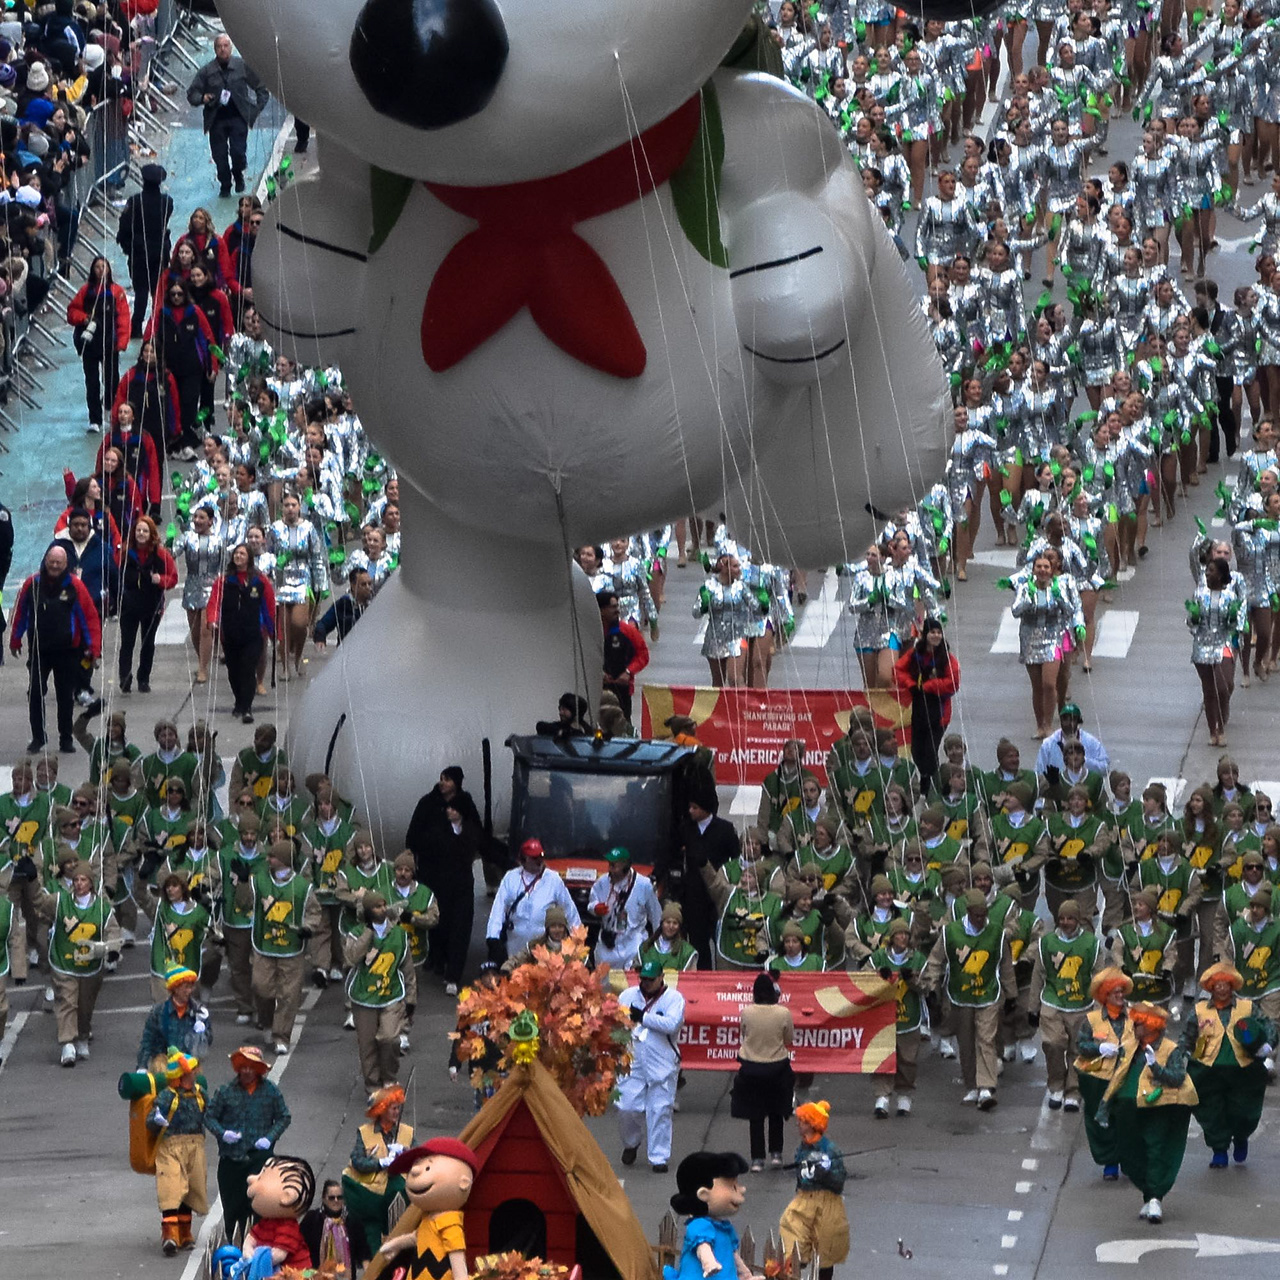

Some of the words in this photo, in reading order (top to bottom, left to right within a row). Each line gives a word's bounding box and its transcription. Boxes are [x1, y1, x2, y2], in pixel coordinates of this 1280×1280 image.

[743, 711, 796, 721] THANKSGIVING
[798, 713, 812, 721] DAY
[763, 722, 792, 732] PARADE
[718, 753, 728, 763] OF
[792, 1027, 864, 1049] SNOOPY
